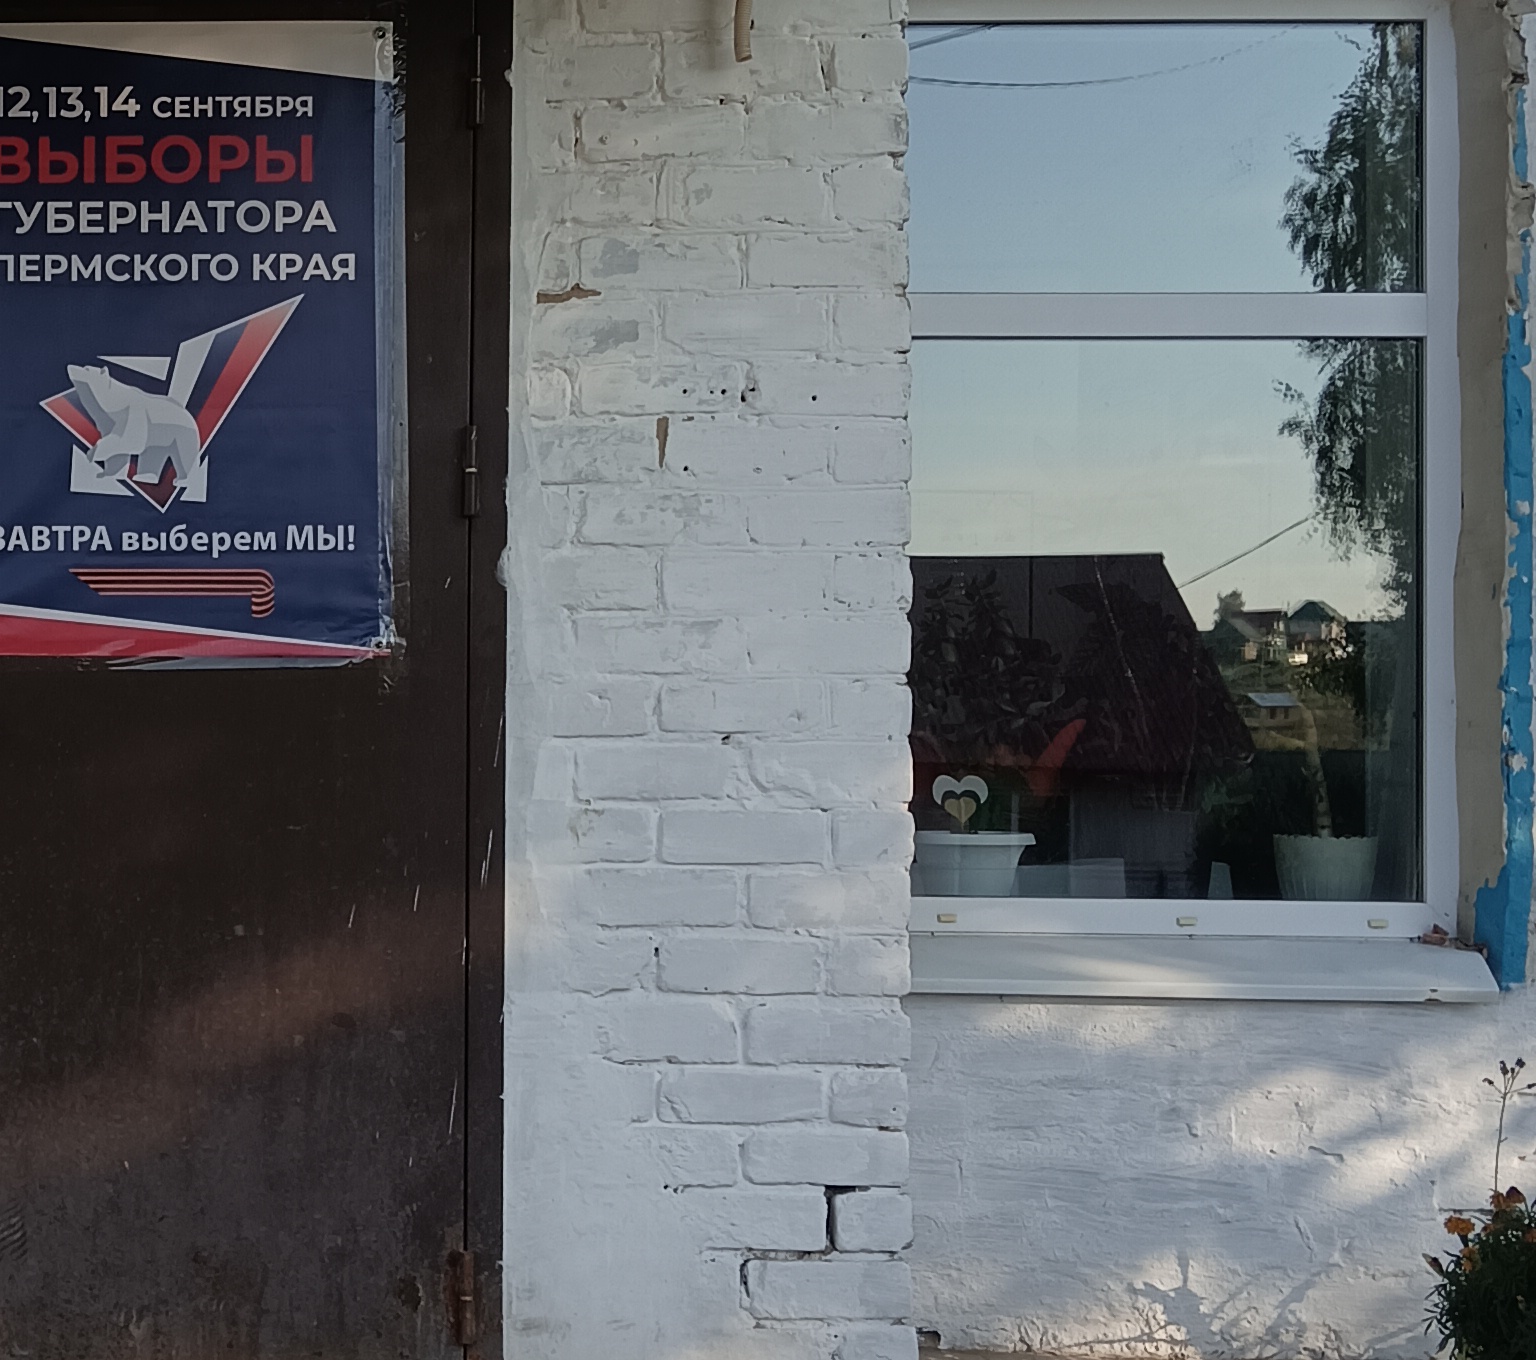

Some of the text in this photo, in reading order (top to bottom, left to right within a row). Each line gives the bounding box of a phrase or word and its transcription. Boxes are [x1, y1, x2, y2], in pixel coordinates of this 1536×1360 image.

[153, 96, 312, 118] СЕНТЯБРЯ
[253, 253, 355, 280] КРАЯ
[122, 524, 276, 558] выберем
[287, 525, 354, 550] МЫ!
